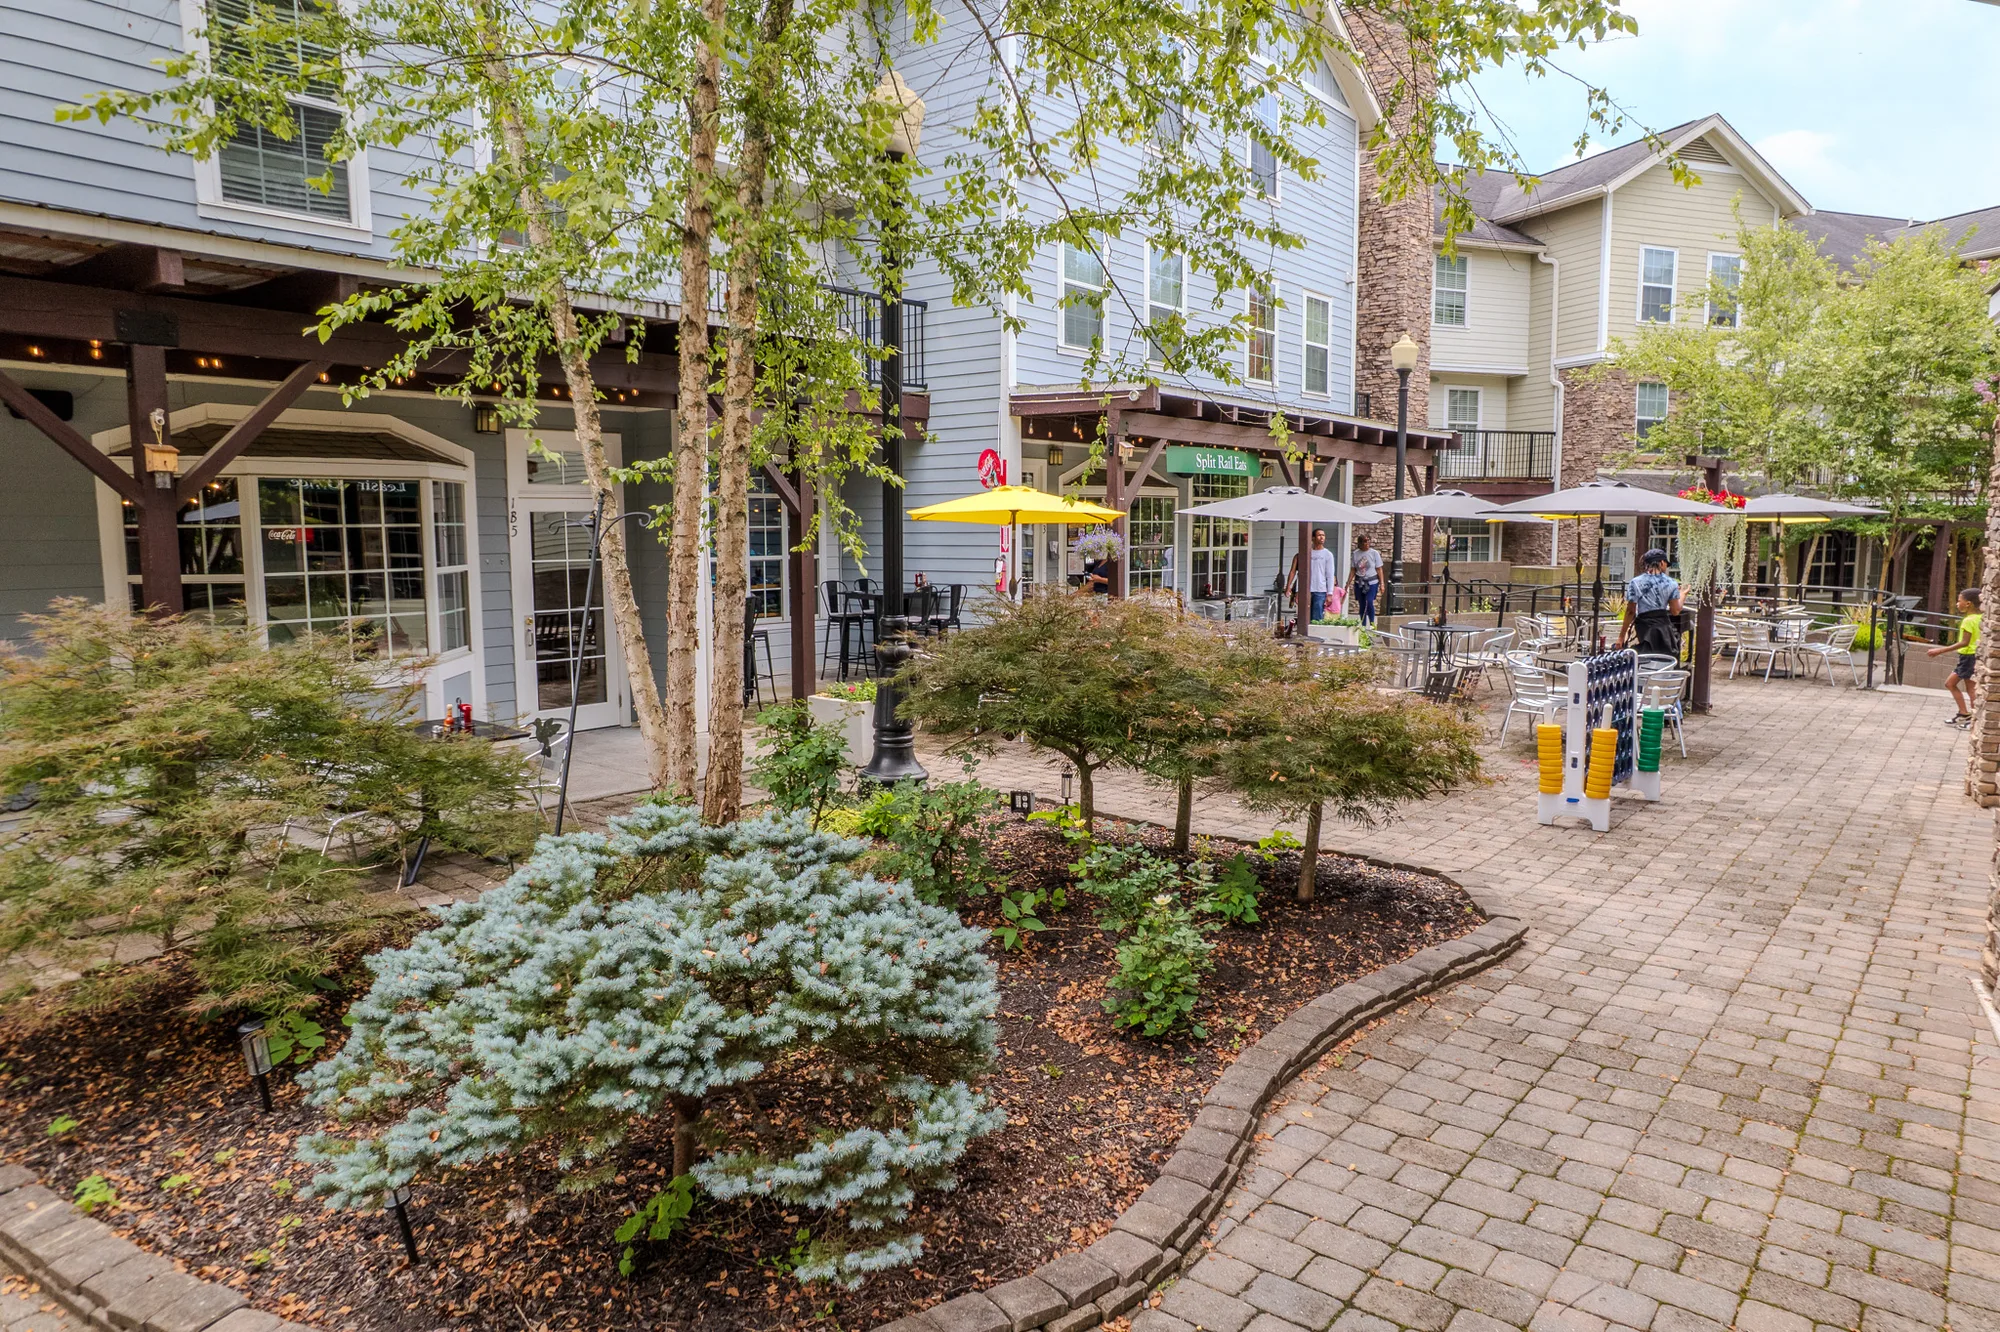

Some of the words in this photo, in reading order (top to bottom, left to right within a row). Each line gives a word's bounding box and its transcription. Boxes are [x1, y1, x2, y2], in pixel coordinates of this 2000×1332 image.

[1195, 452, 1216, 471] Split
[1217, 454, 1234, 470] Rail
[1234, 455, 1248, 471] Eats
[268, 529, 296, 541] Coca-Cola
